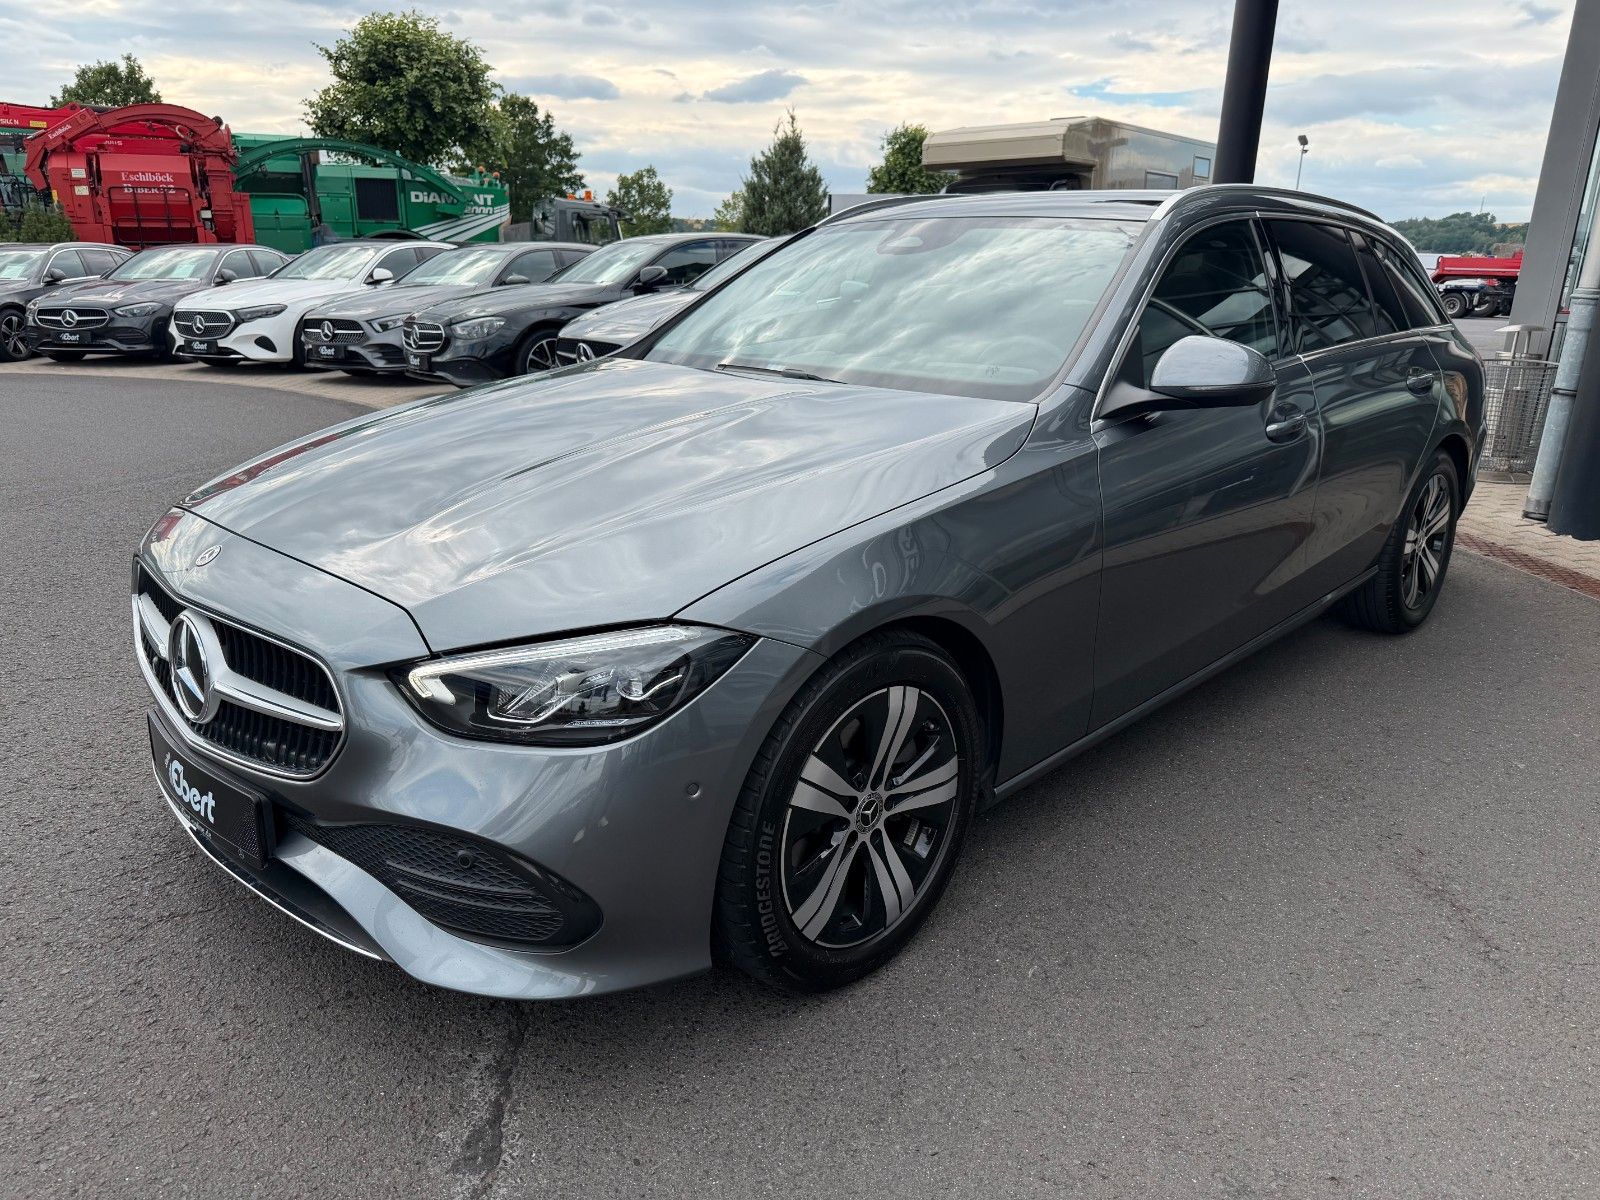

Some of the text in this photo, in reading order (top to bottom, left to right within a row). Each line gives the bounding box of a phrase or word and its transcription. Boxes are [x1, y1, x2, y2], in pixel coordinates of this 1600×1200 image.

[121, 171, 174, 182] Eschlböck
[169, 760, 216, 824] Ebert
[755, 820, 789, 958] BRIDGESTONE
